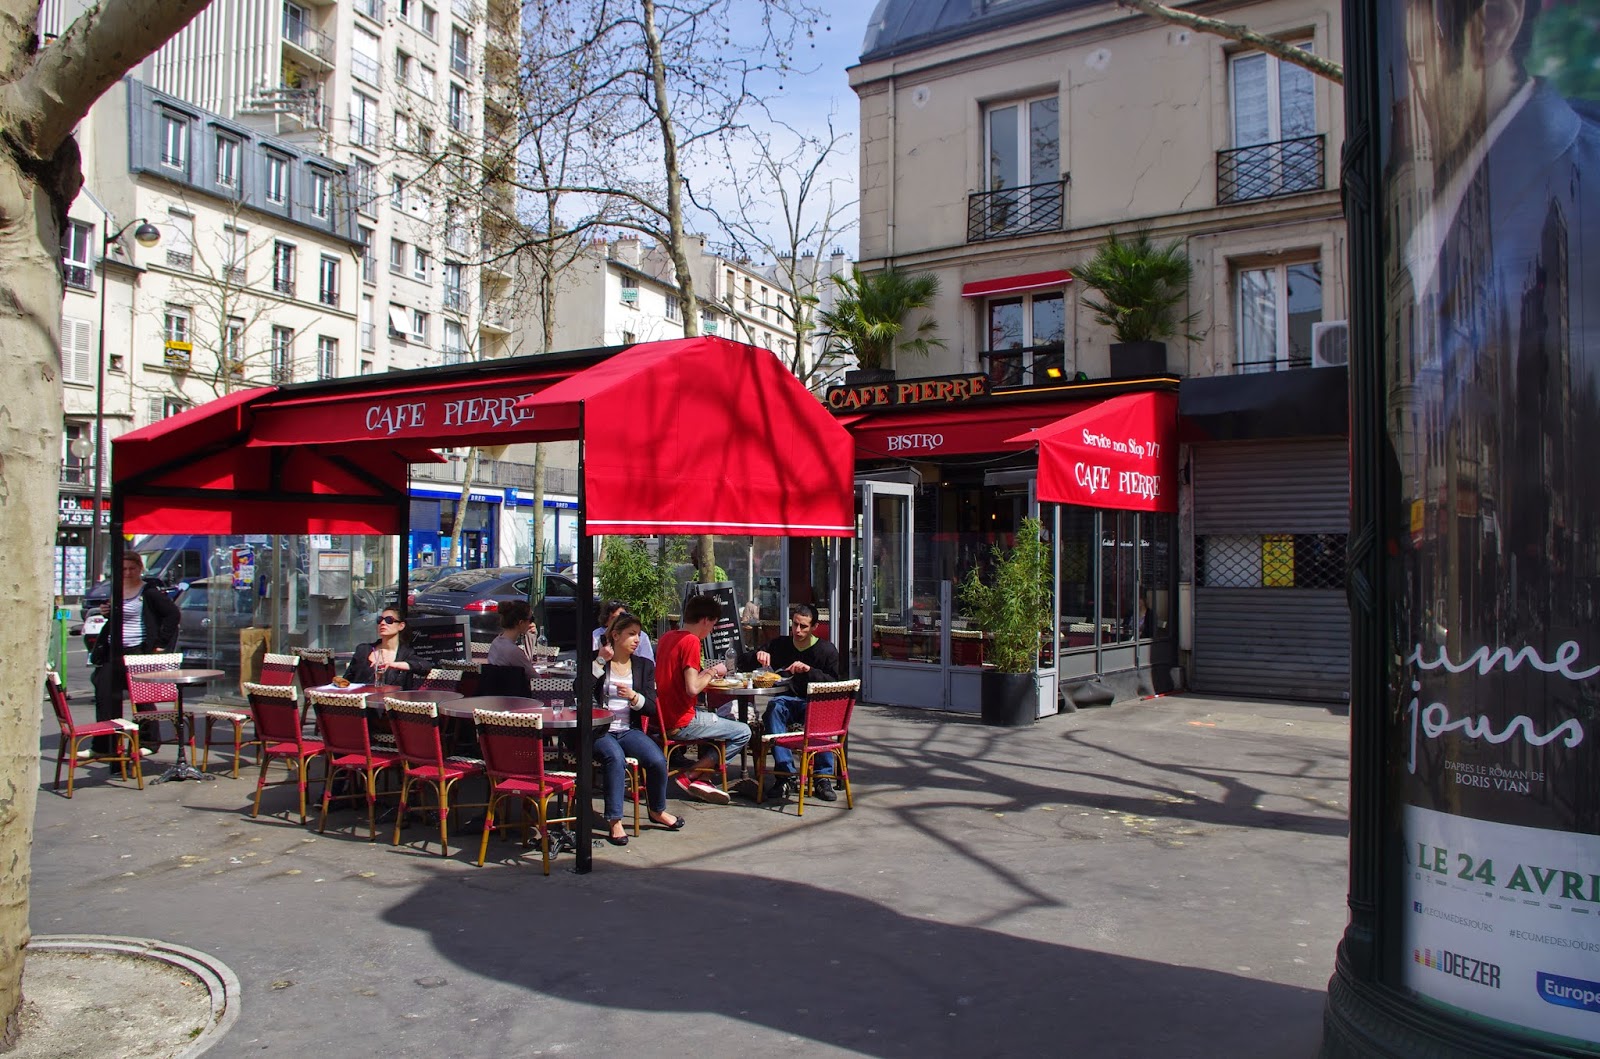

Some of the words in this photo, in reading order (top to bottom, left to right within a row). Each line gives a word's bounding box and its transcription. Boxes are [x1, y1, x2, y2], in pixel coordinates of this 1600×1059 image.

[829, 384, 890, 410] CAFE
[896, 375, 986, 402] PIERRE
[365, 402, 426, 436] CAFE
[442, 393, 535, 427] PIERRE
[887, 433, 944, 452] BISTRO
[1082, 428, 1112, 449] Service
[1113, 441, 1127, 453] non
[1128, 438, 1145, 459] Stop
[1146, 441, 1160, 459] 7/7
[1074, 461, 1111, 495] CAFE
[1118, 471, 1160, 501] PIERRE
[1407, 680, 1584, 775] jours
[1455, 772, 1490, 789] BORIS
[1494, 778, 1530, 793] VIAN
[1476, 765, 1487, 775] LE
[1489, 767, 1528, 780] ROMAN
[1531, 771, 1545, 782] DE
[1417, 842, 1448, 875] LE
[1457, 853, 1496, 886] 24
[1444, 950, 1500, 989] DEEZER
